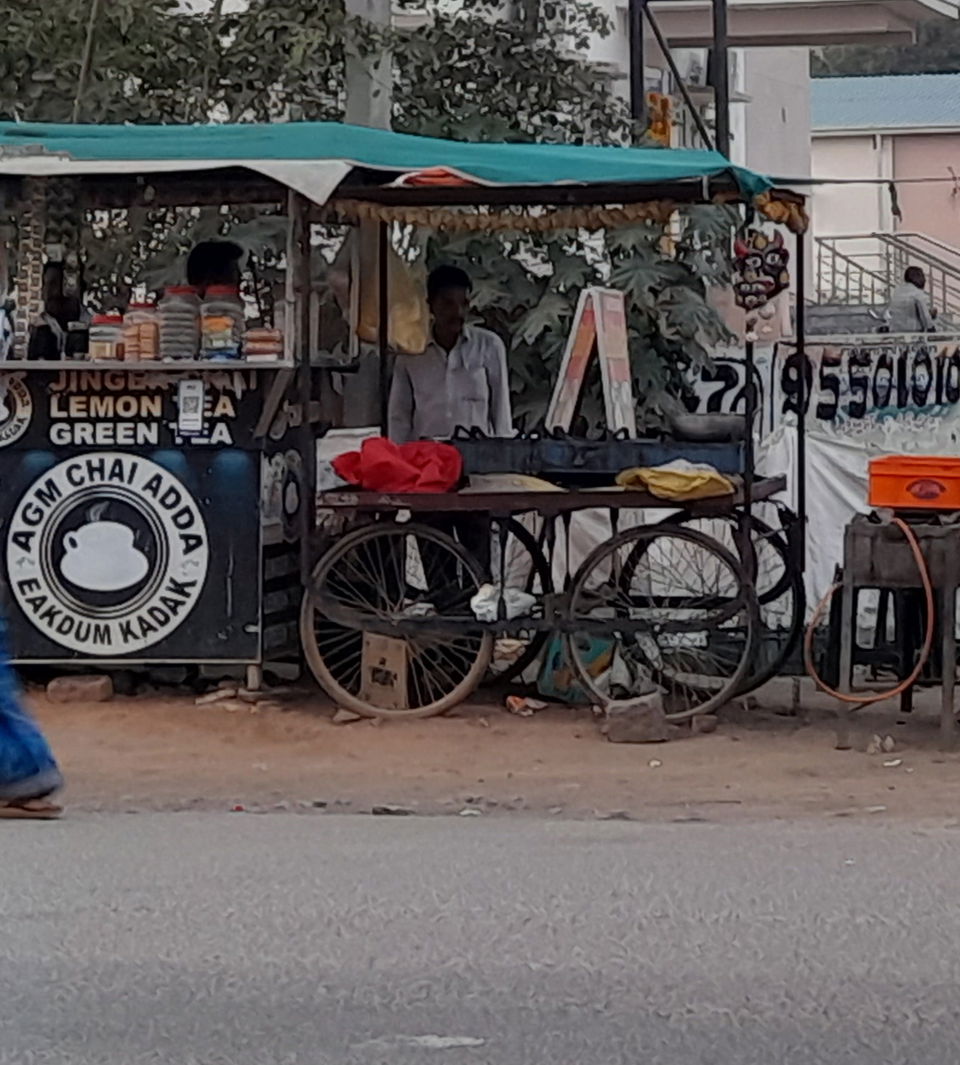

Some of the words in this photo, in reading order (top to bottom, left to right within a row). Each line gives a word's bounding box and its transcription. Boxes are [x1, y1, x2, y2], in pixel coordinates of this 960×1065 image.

[50, 395, 162, 418] LEMON
[49, 422, 158, 445] GREEN
[12, 478, 62, 553] AGM
[66, 458, 138, 487] CHAI
[141, 473, 203, 555] ADDA
[16, 578, 112, 645] EAKDUM
[119, 577, 198, 643] KADAK
